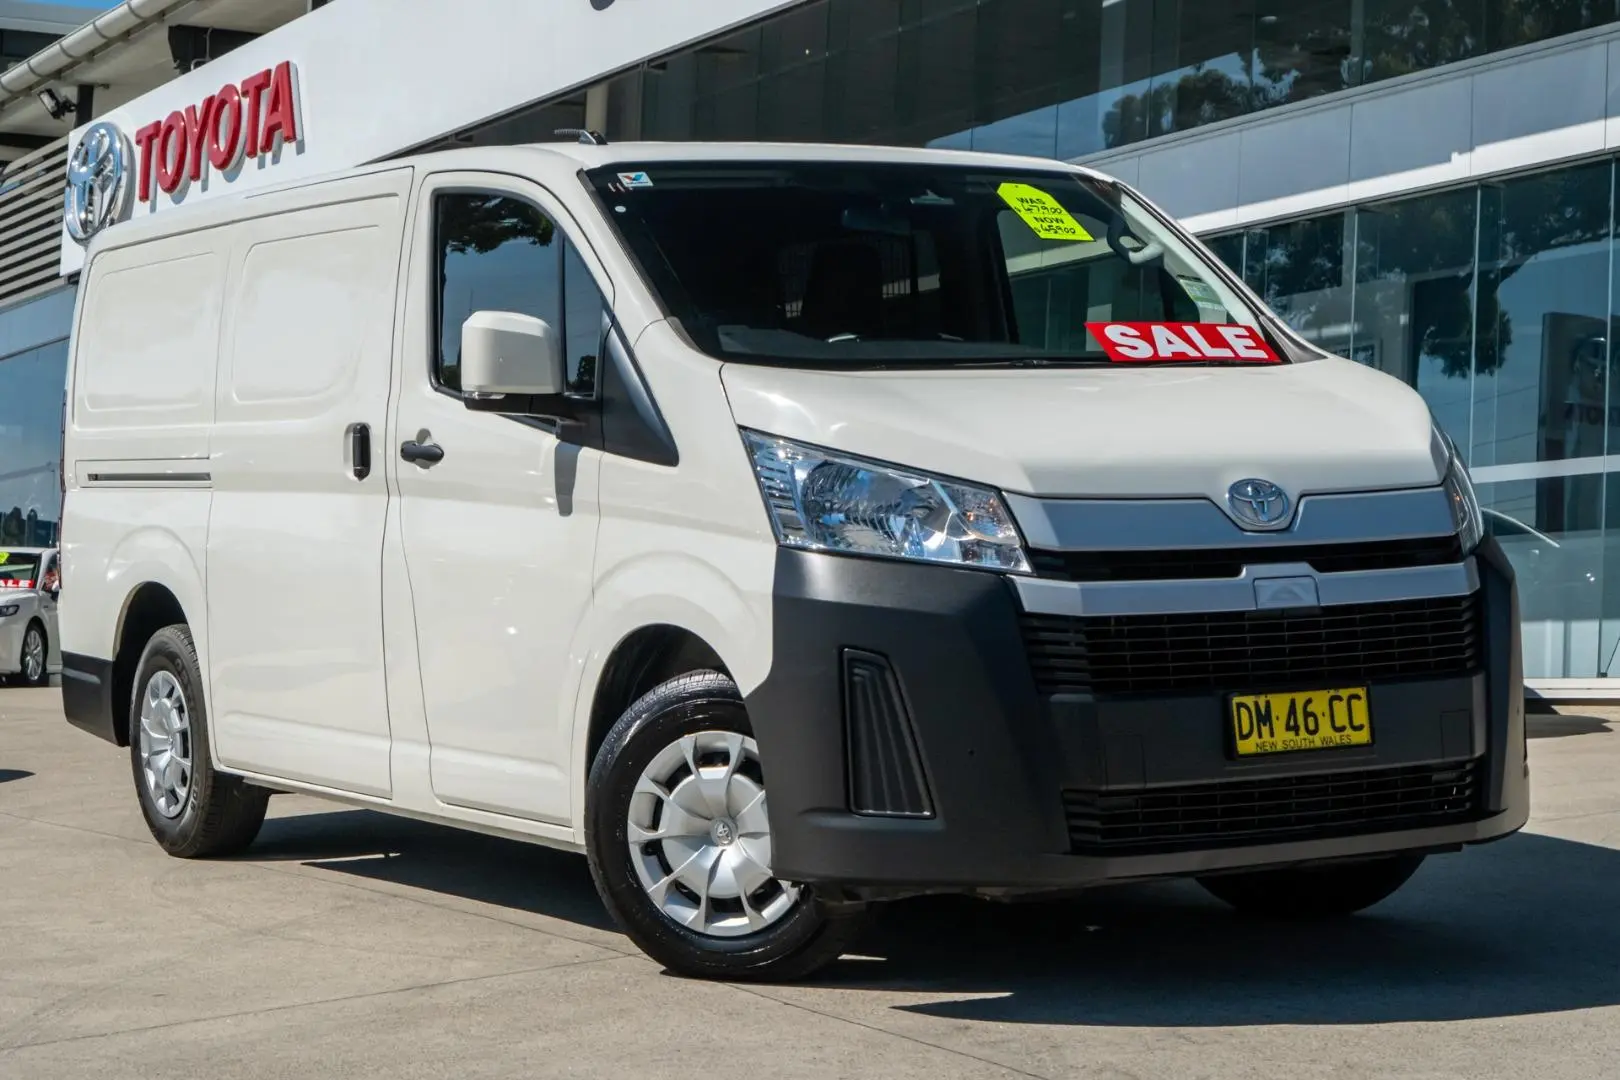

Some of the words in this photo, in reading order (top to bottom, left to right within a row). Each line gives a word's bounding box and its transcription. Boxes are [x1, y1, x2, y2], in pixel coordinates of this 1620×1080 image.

[135, 61, 298, 203] TOYOTA
[1016, 197, 1046, 205] WAS
[1033, 216, 1065, 224] NOW
[1104, 325, 1269, 359] SALE
[1255, 742, 1278, 752] NEW
[1282, 737, 1315, 750] SOUTH
[1320, 734, 1352, 746] WALES
